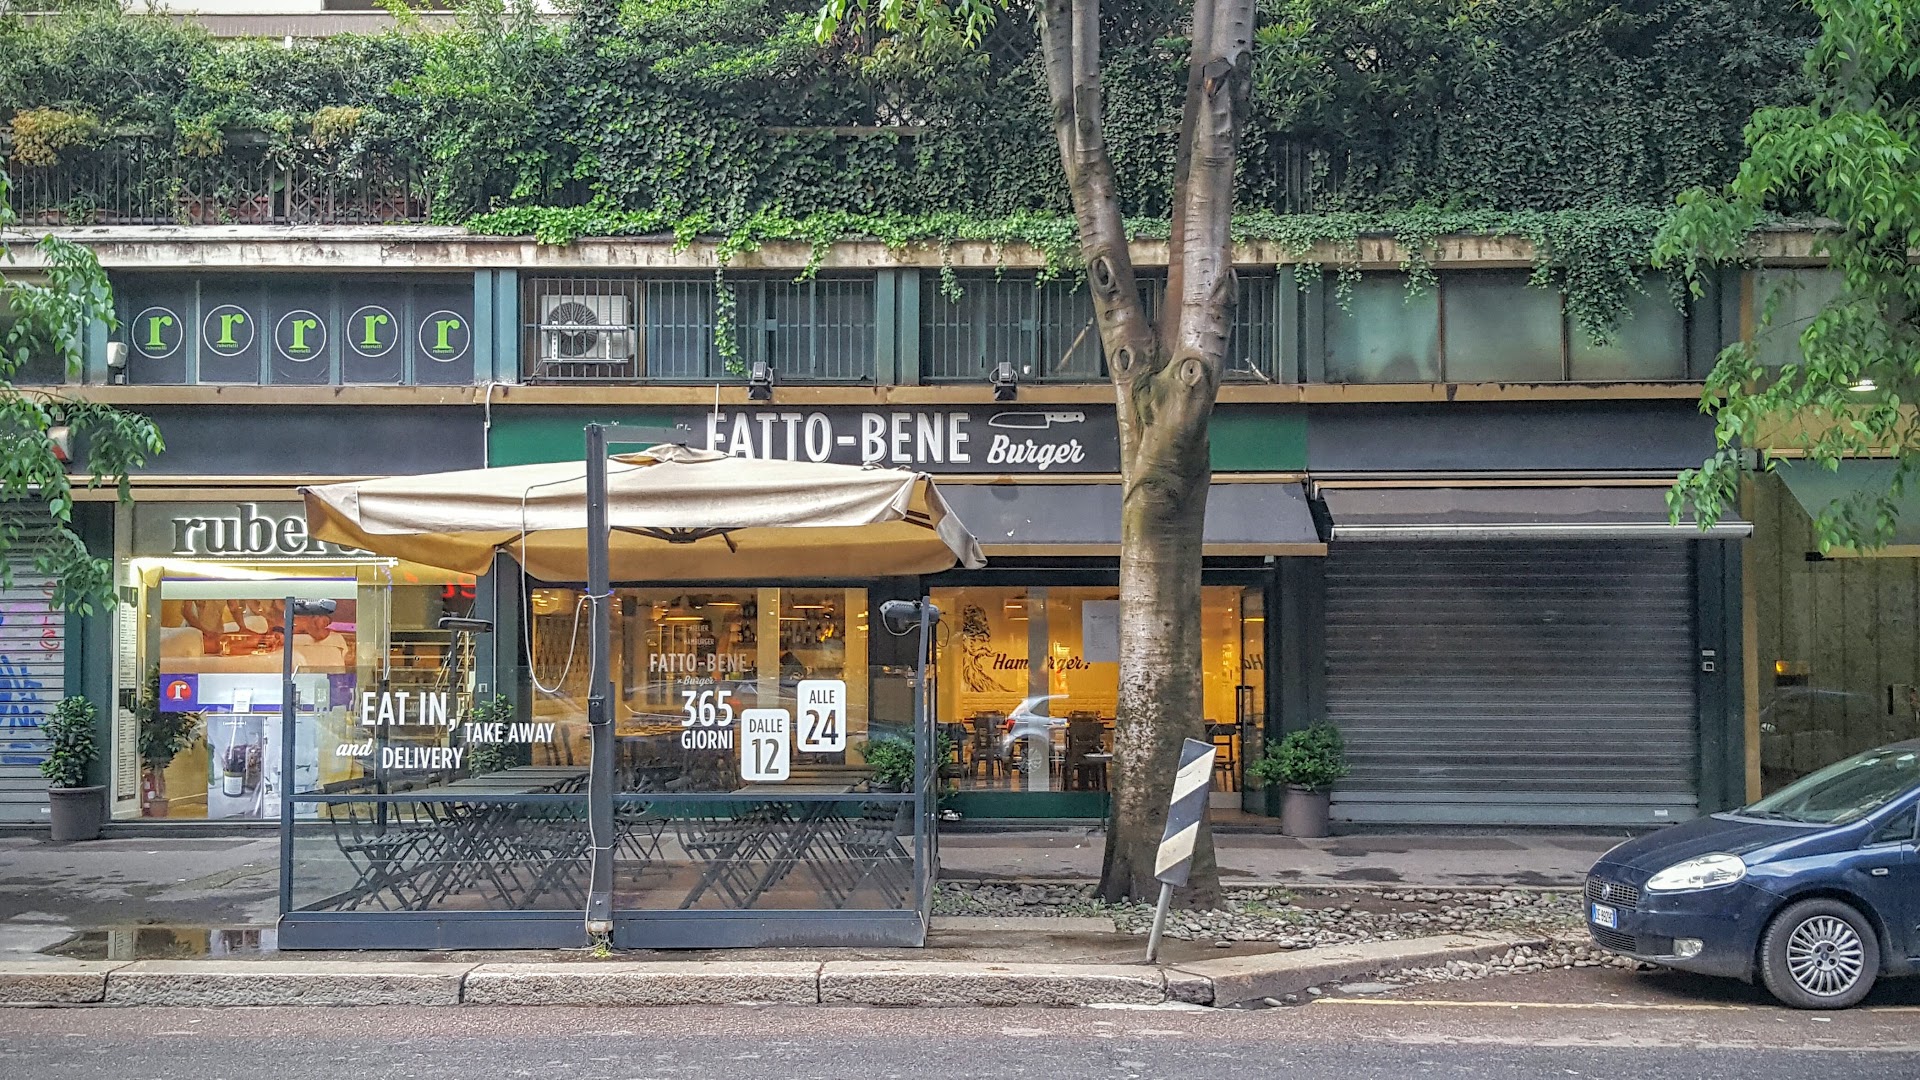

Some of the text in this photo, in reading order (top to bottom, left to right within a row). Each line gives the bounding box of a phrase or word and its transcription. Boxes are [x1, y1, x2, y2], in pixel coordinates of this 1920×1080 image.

[145, 316, 172, 345] r
[217, 314, 244, 343] r
[289, 319, 317, 348] r
[361, 314, 388, 344] r
[432, 319, 460, 348] r
[706, 412, 972, 464] FATTO-BENE
[987, 434, 1086, 471] Burger
[684, 638, 715, 646] HAMBURGER
[650, 653, 747, 673] FATTO-BENE
[173, 684, 187, 701] r
[683, 674, 715, 687] Burger
[362, 691, 456, 732] EAT IN,
[681, 690, 734, 728] 365
[809, 690, 836, 704] ALLE
[464, 722, 556, 743] TAKE AWAY
[681, 730, 734, 750] GIORNI
[749, 718, 783, 733] DALLE
[805, 709, 839, 745] 24
[335, 738, 464, 769] and DELIVERY
[751, 738, 780, 775] 12
